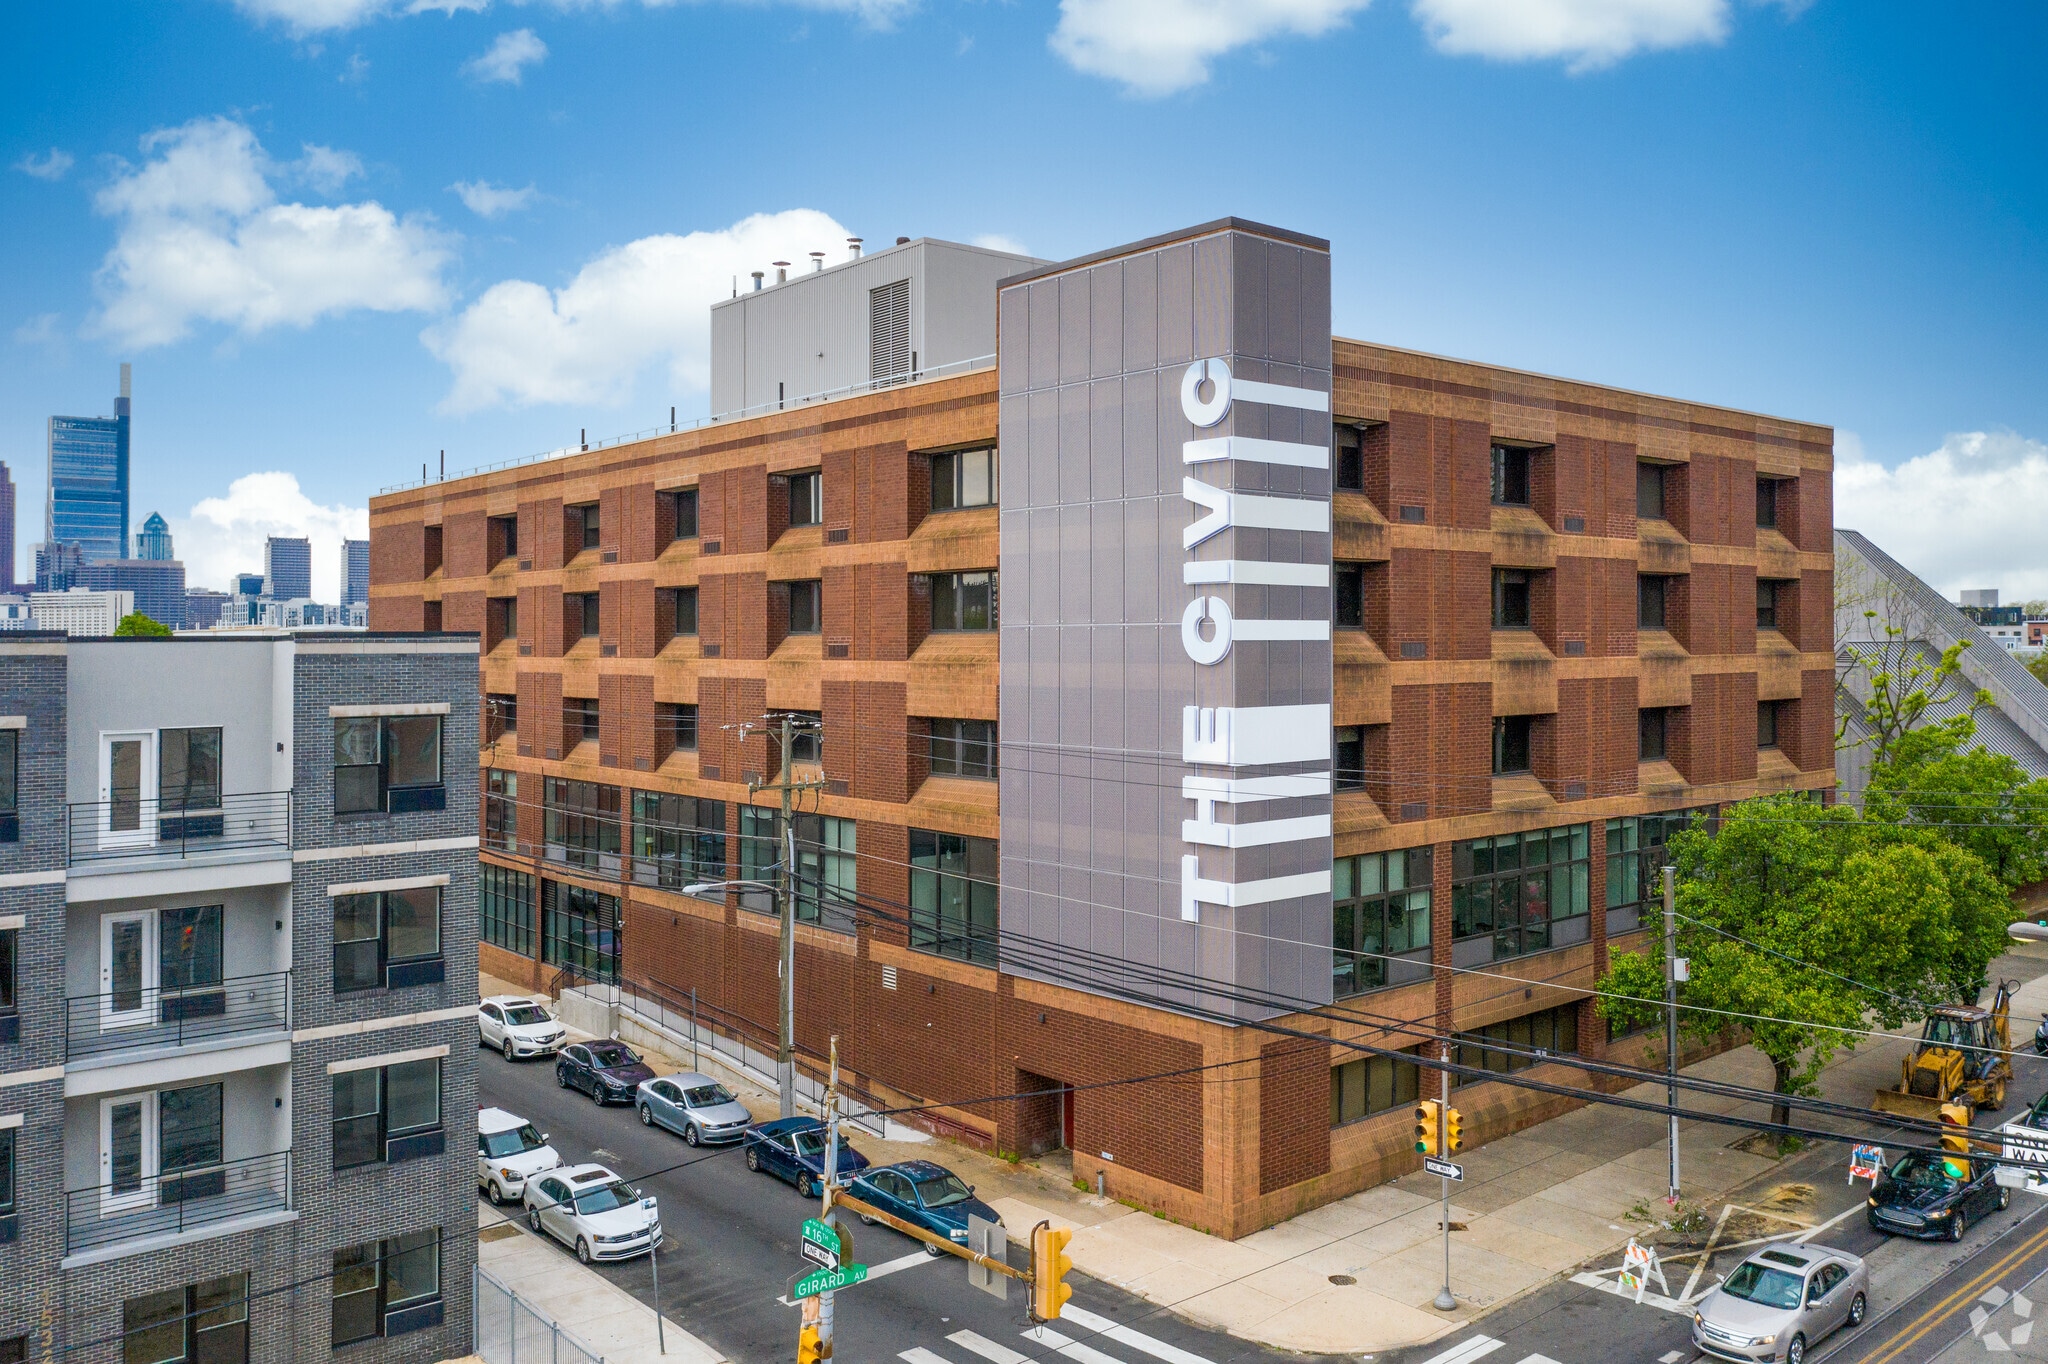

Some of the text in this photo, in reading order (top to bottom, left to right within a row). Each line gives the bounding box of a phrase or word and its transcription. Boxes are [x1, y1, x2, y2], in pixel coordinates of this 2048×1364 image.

[1181, 358, 1235, 922] THE CIVIC
[1428, 1162, 1438, 1170] ONE
[812, 1228, 829, 1243] 16TH
[831, 1242, 839, 1252] ST
[806, 1245, 830, 1261] ONE WAY
[798, 1270, 865, 1296] GIRARD AV
